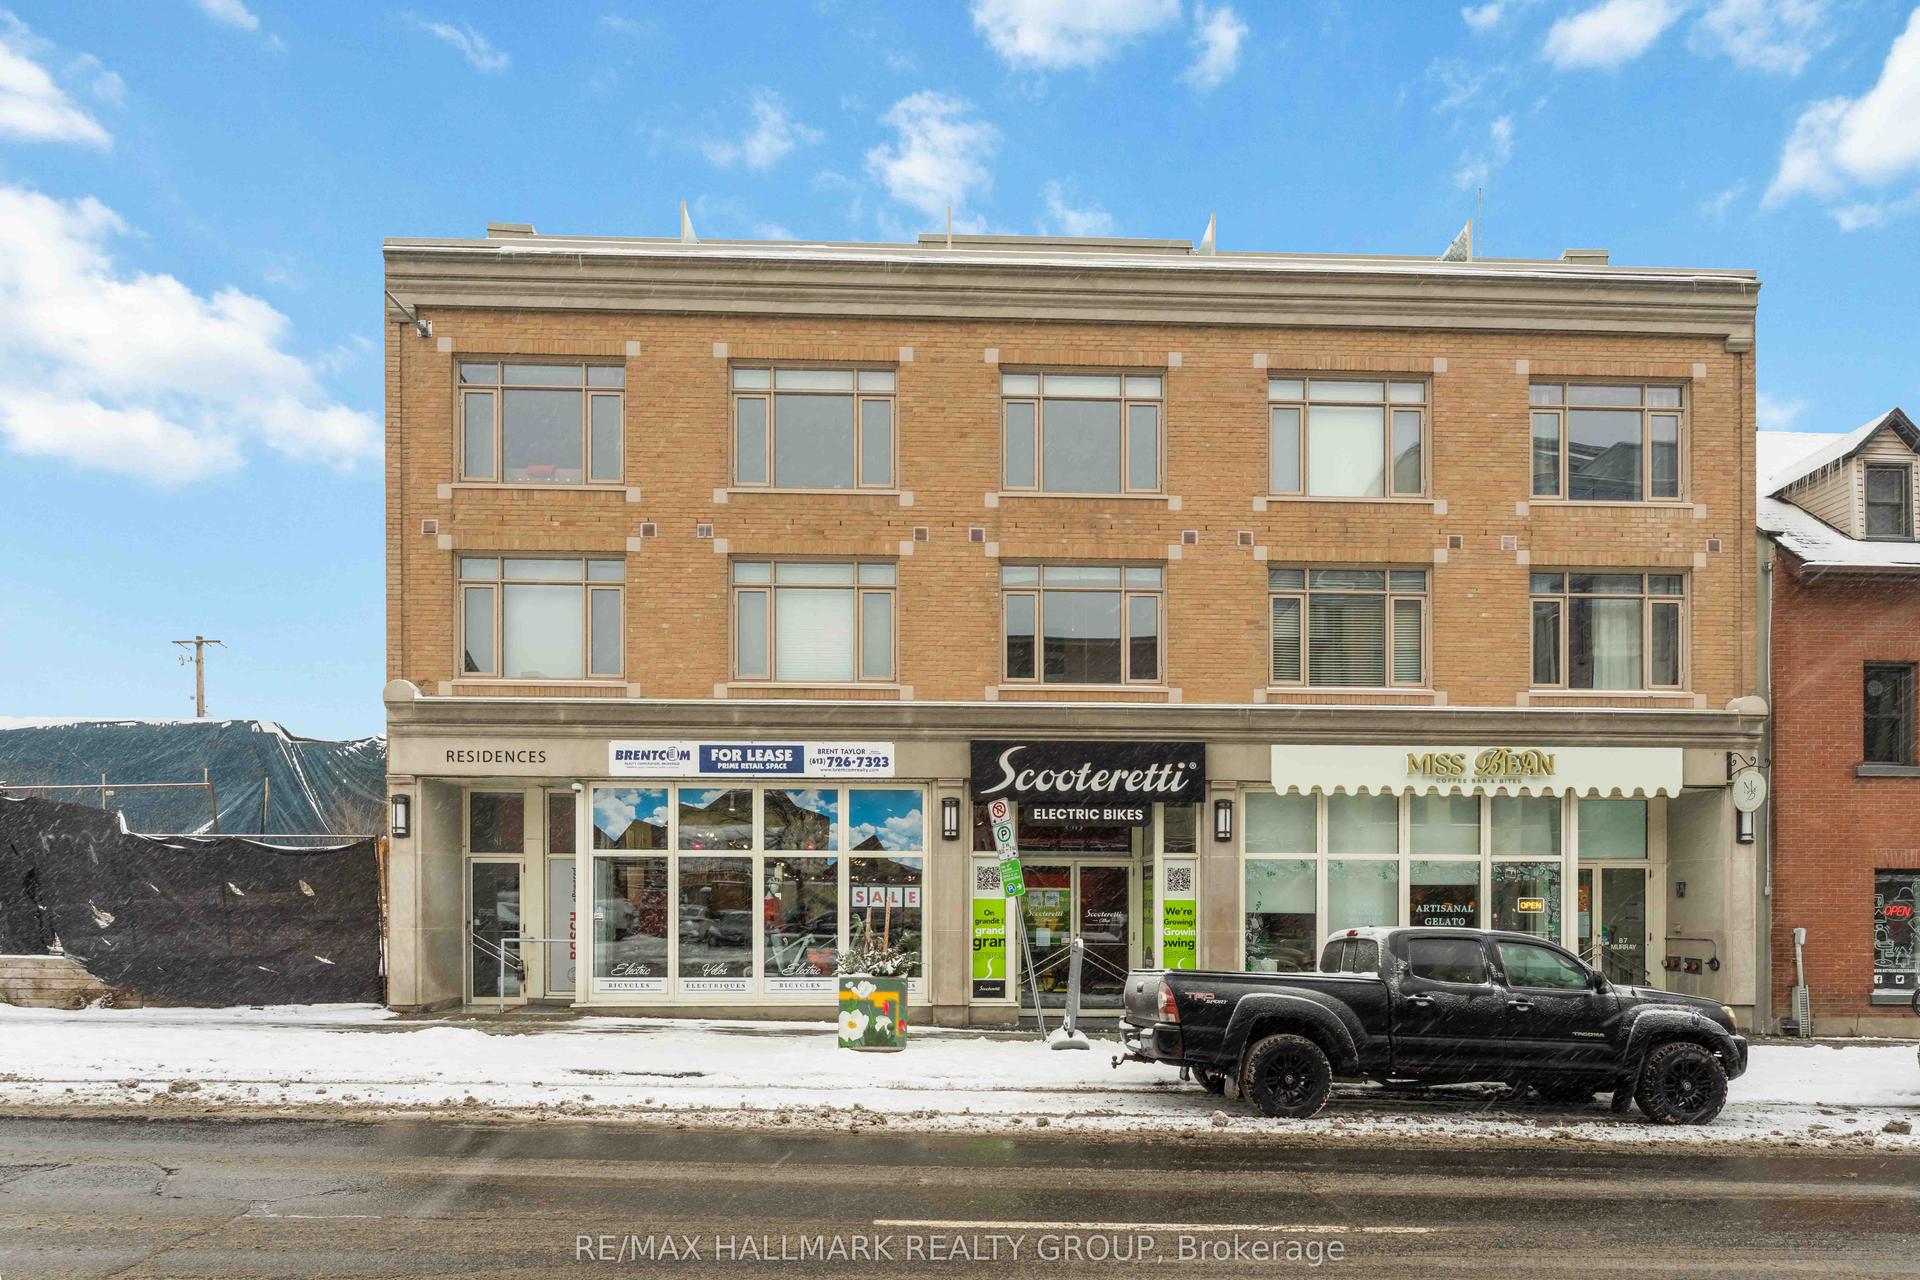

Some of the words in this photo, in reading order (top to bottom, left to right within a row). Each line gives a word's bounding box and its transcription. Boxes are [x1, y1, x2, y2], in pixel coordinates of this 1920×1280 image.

[446, 750, 547, 763] RESIDENCES
[615, 746, 691, 761] BRENTCOM
[711, 749, 741, 761] FOR
[747, 749, 792, 762] LEASE
[1406, 752, 1467, 776] MISS
[1473, 747, 1556, 776] BEAN
[1034, 808, 1100, 820] ELECTRIC
[1103, 809, 1143, 820] BIKES
[855, 891, 917, 903] SALE
[1165, 907, 1192, 915] We're
[1416, 904, 1474, 913] ARTISANAL
[1884, 905, 1911, 917] OPEN
[1424, 917, 1466, 926] GELATO
[973, 938, 1005, 951] gran
[611, 962, 651, 976] Electric
[782, 963, 821, 976] Electric
[1184, 991, 1216, 1001] TRD
